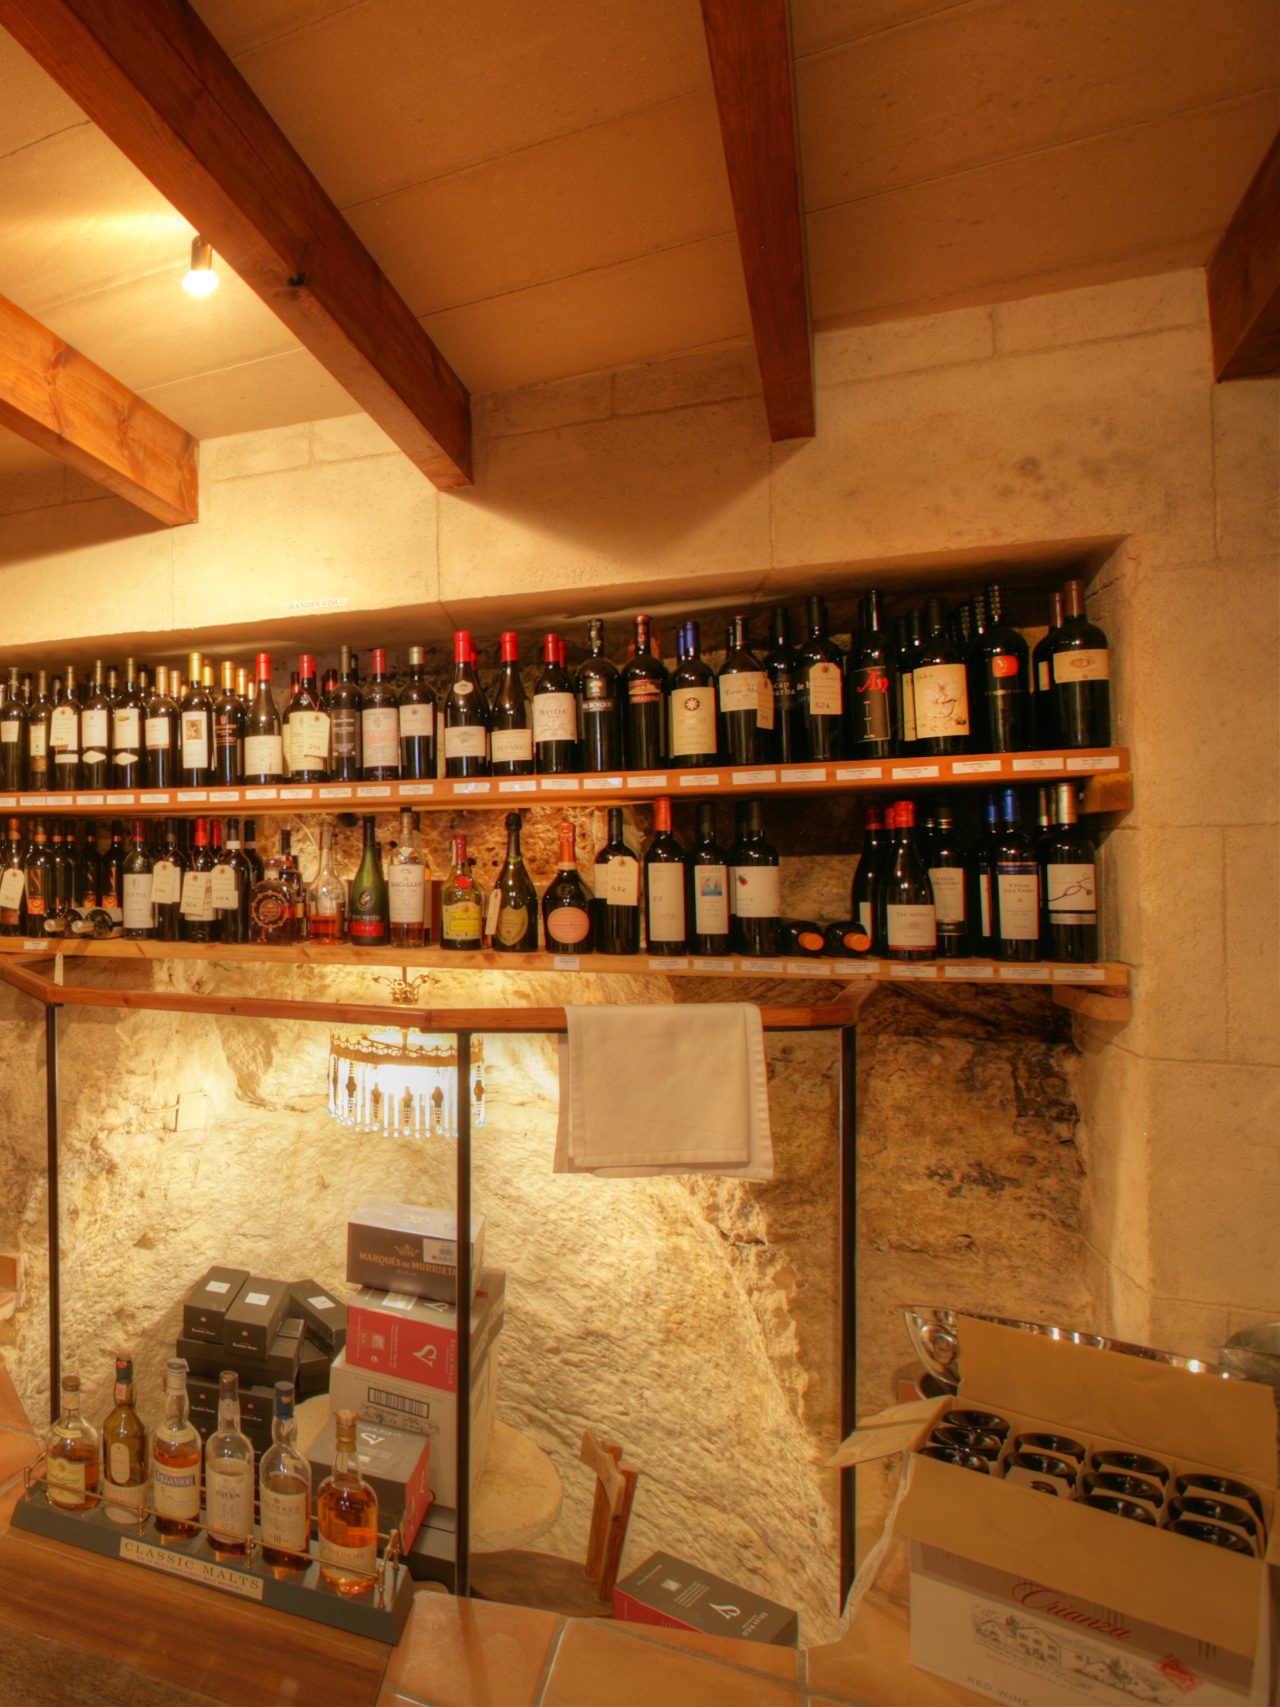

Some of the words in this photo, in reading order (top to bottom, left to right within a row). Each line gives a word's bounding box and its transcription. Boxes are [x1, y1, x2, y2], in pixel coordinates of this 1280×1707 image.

[124, 1541, 195, 1570] CLASSIC
[202, 1564, 260, 1590] MALTS
[1011, 1581, 1132, 1639] Crianza
